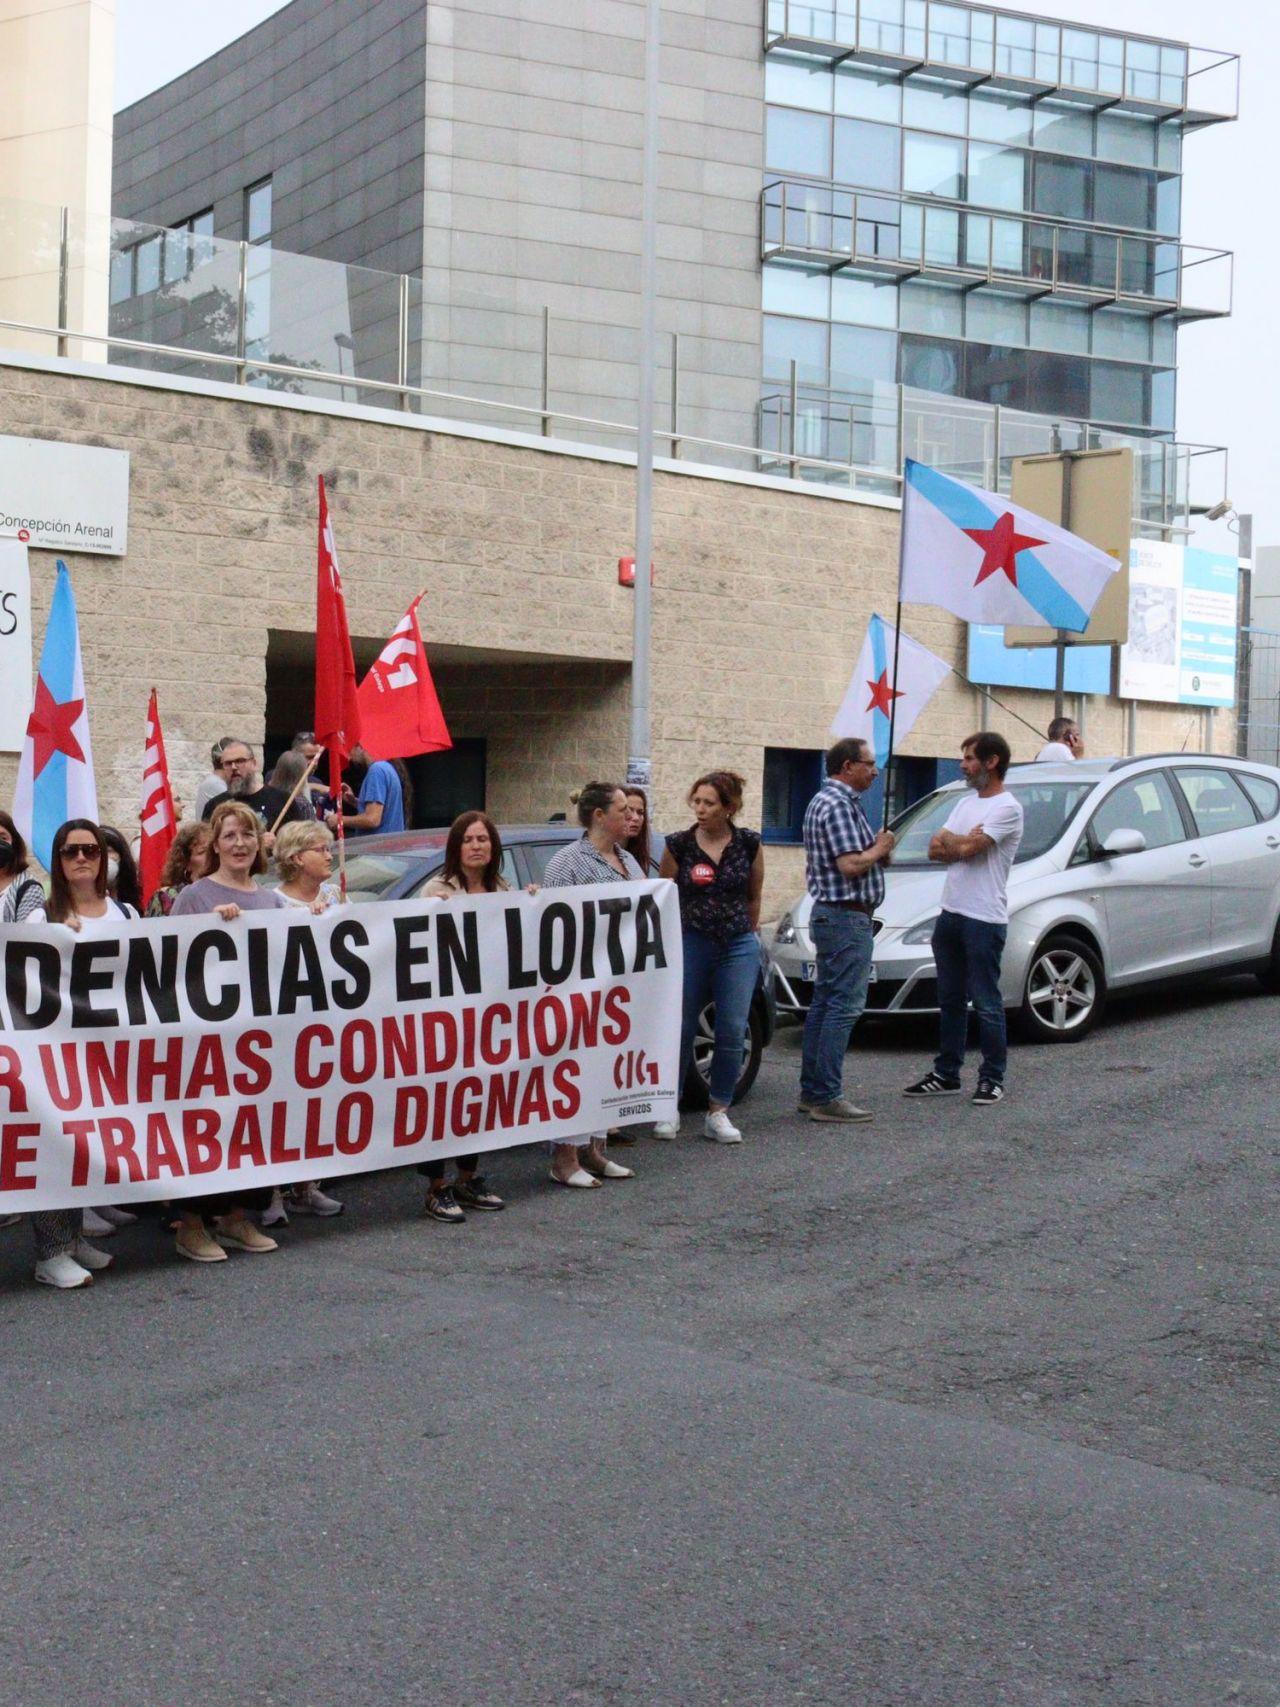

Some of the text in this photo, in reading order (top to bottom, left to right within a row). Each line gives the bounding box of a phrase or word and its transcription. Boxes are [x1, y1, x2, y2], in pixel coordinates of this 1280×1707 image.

[74, 522, 113, 538] Arenal
[393, 911, 481, 1002] EN
[504, 893, 667, 990] LOITA
[38, 1029, 272, 1111] UNHAS
[294, 984, 632, 1090] CONDICIÓNS
[613, 1049, 659, 1090] CIG
[63, 1091, 373, 1187] TRABALLO
[393, 1059, 581, 1148] DIGNAS
[618, 1103, 652, 1118] SERVIZOS
